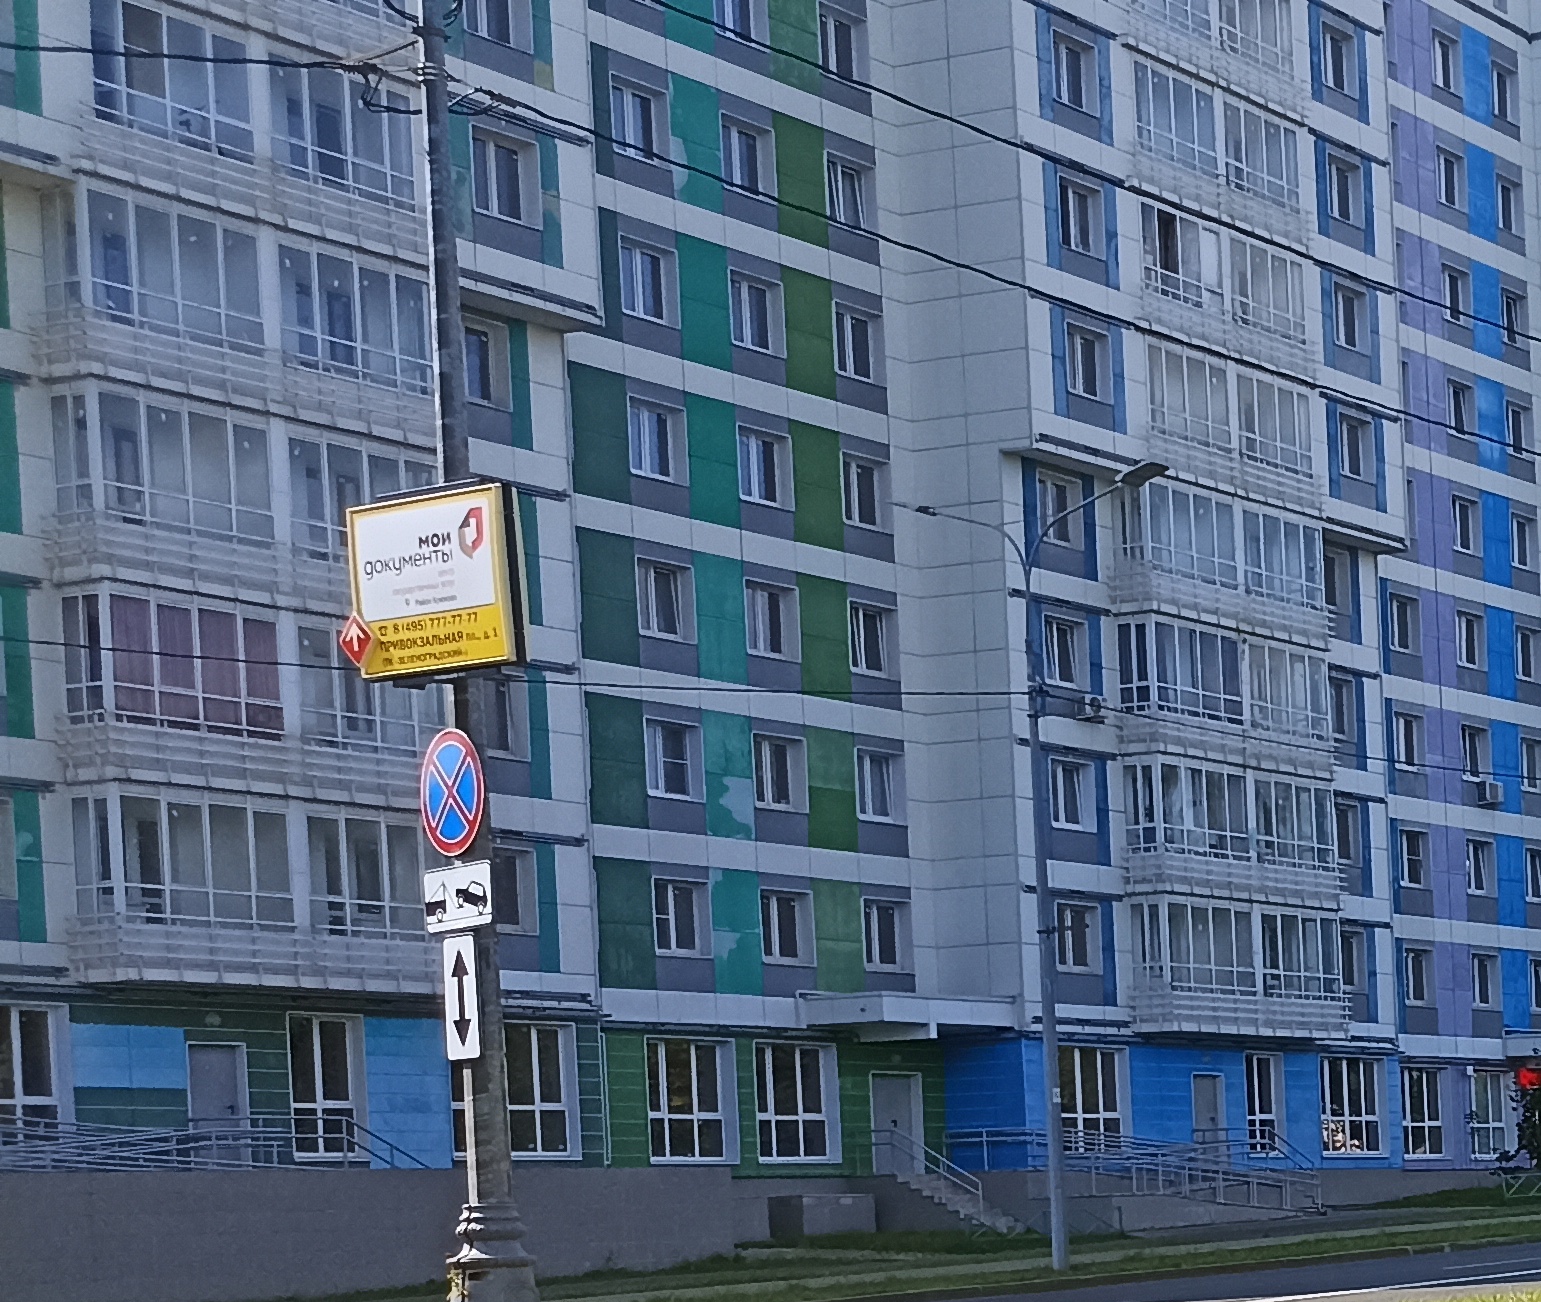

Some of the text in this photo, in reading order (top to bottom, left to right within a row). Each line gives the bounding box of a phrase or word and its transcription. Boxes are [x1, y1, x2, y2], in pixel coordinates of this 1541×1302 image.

[418, 531, 451, 549] мои
[364, 548, 453, 581] документы
[393, 612, 478, 634] 8 (495) 777-77-77
[380, 631, 464, 652] ПРИВОКЗАЛЬНАЯ
